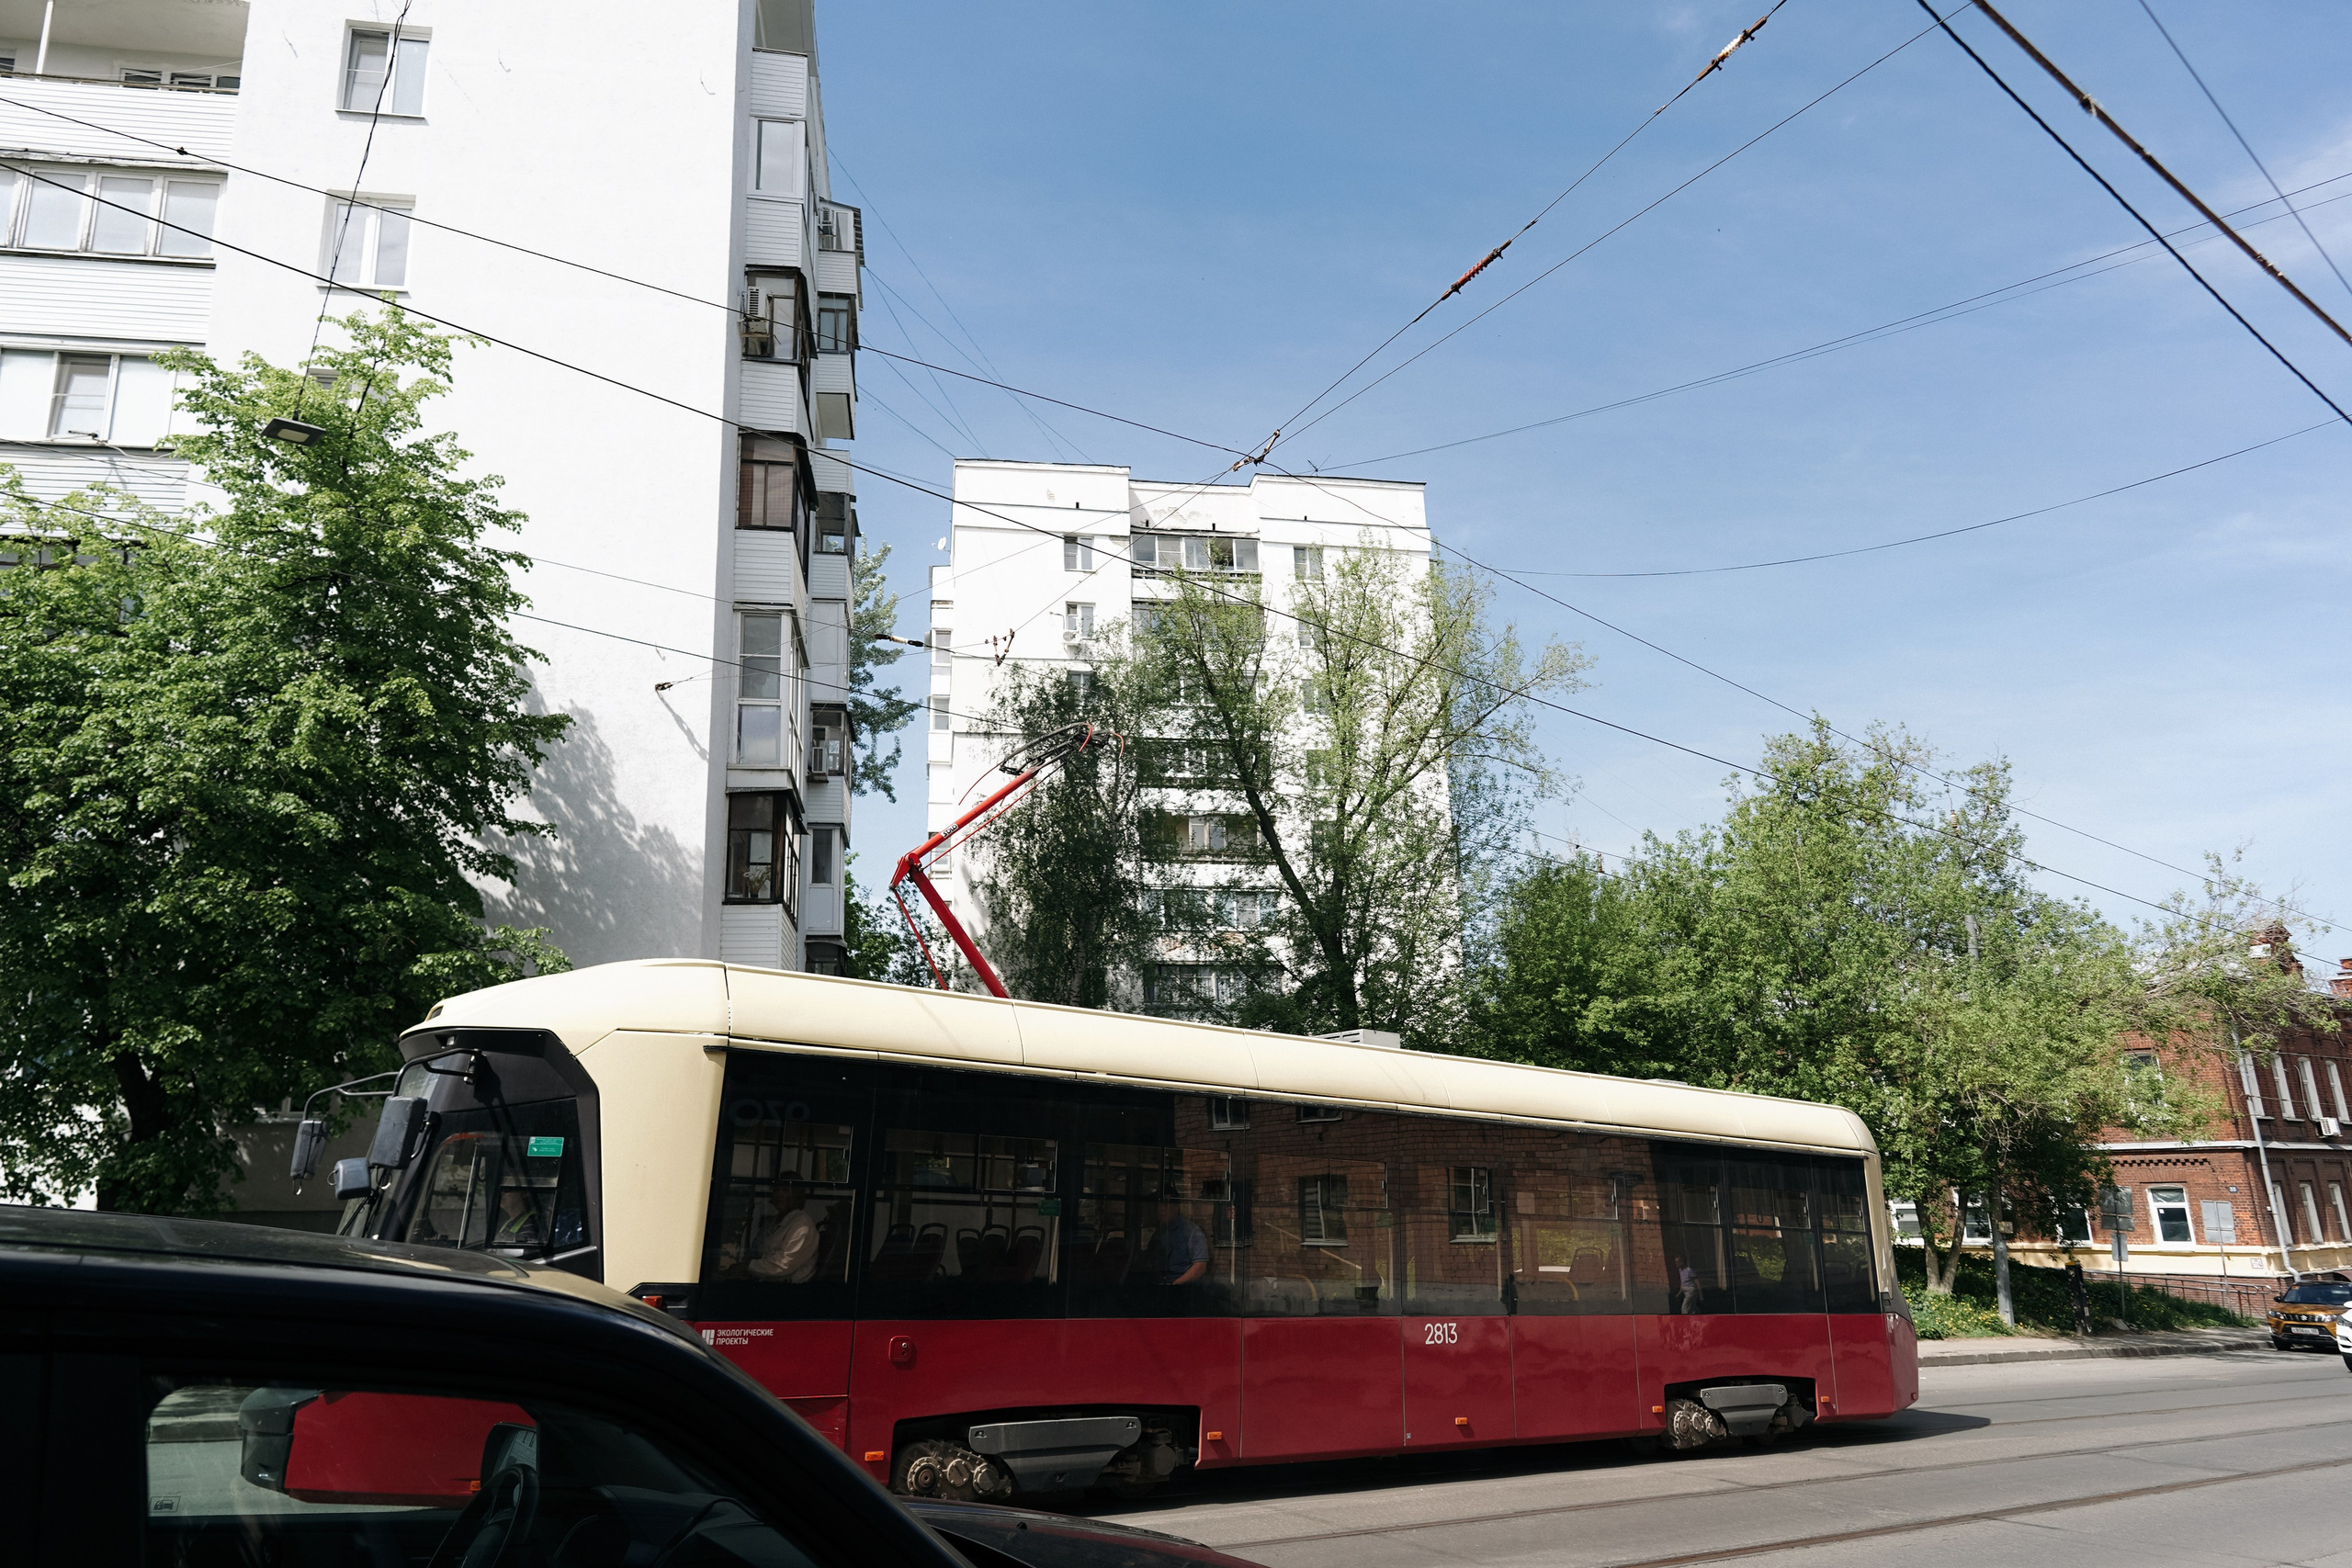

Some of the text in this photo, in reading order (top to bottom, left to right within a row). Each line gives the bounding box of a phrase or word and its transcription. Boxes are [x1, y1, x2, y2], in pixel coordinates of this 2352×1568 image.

[717, 1328, 774, 1337] ЭКОЛОГИЧЕСКИЕ
[1424, 1323, 1458, 1345] 2813
[716, 1337, 749, 1346] ПРОЕКТЫ
